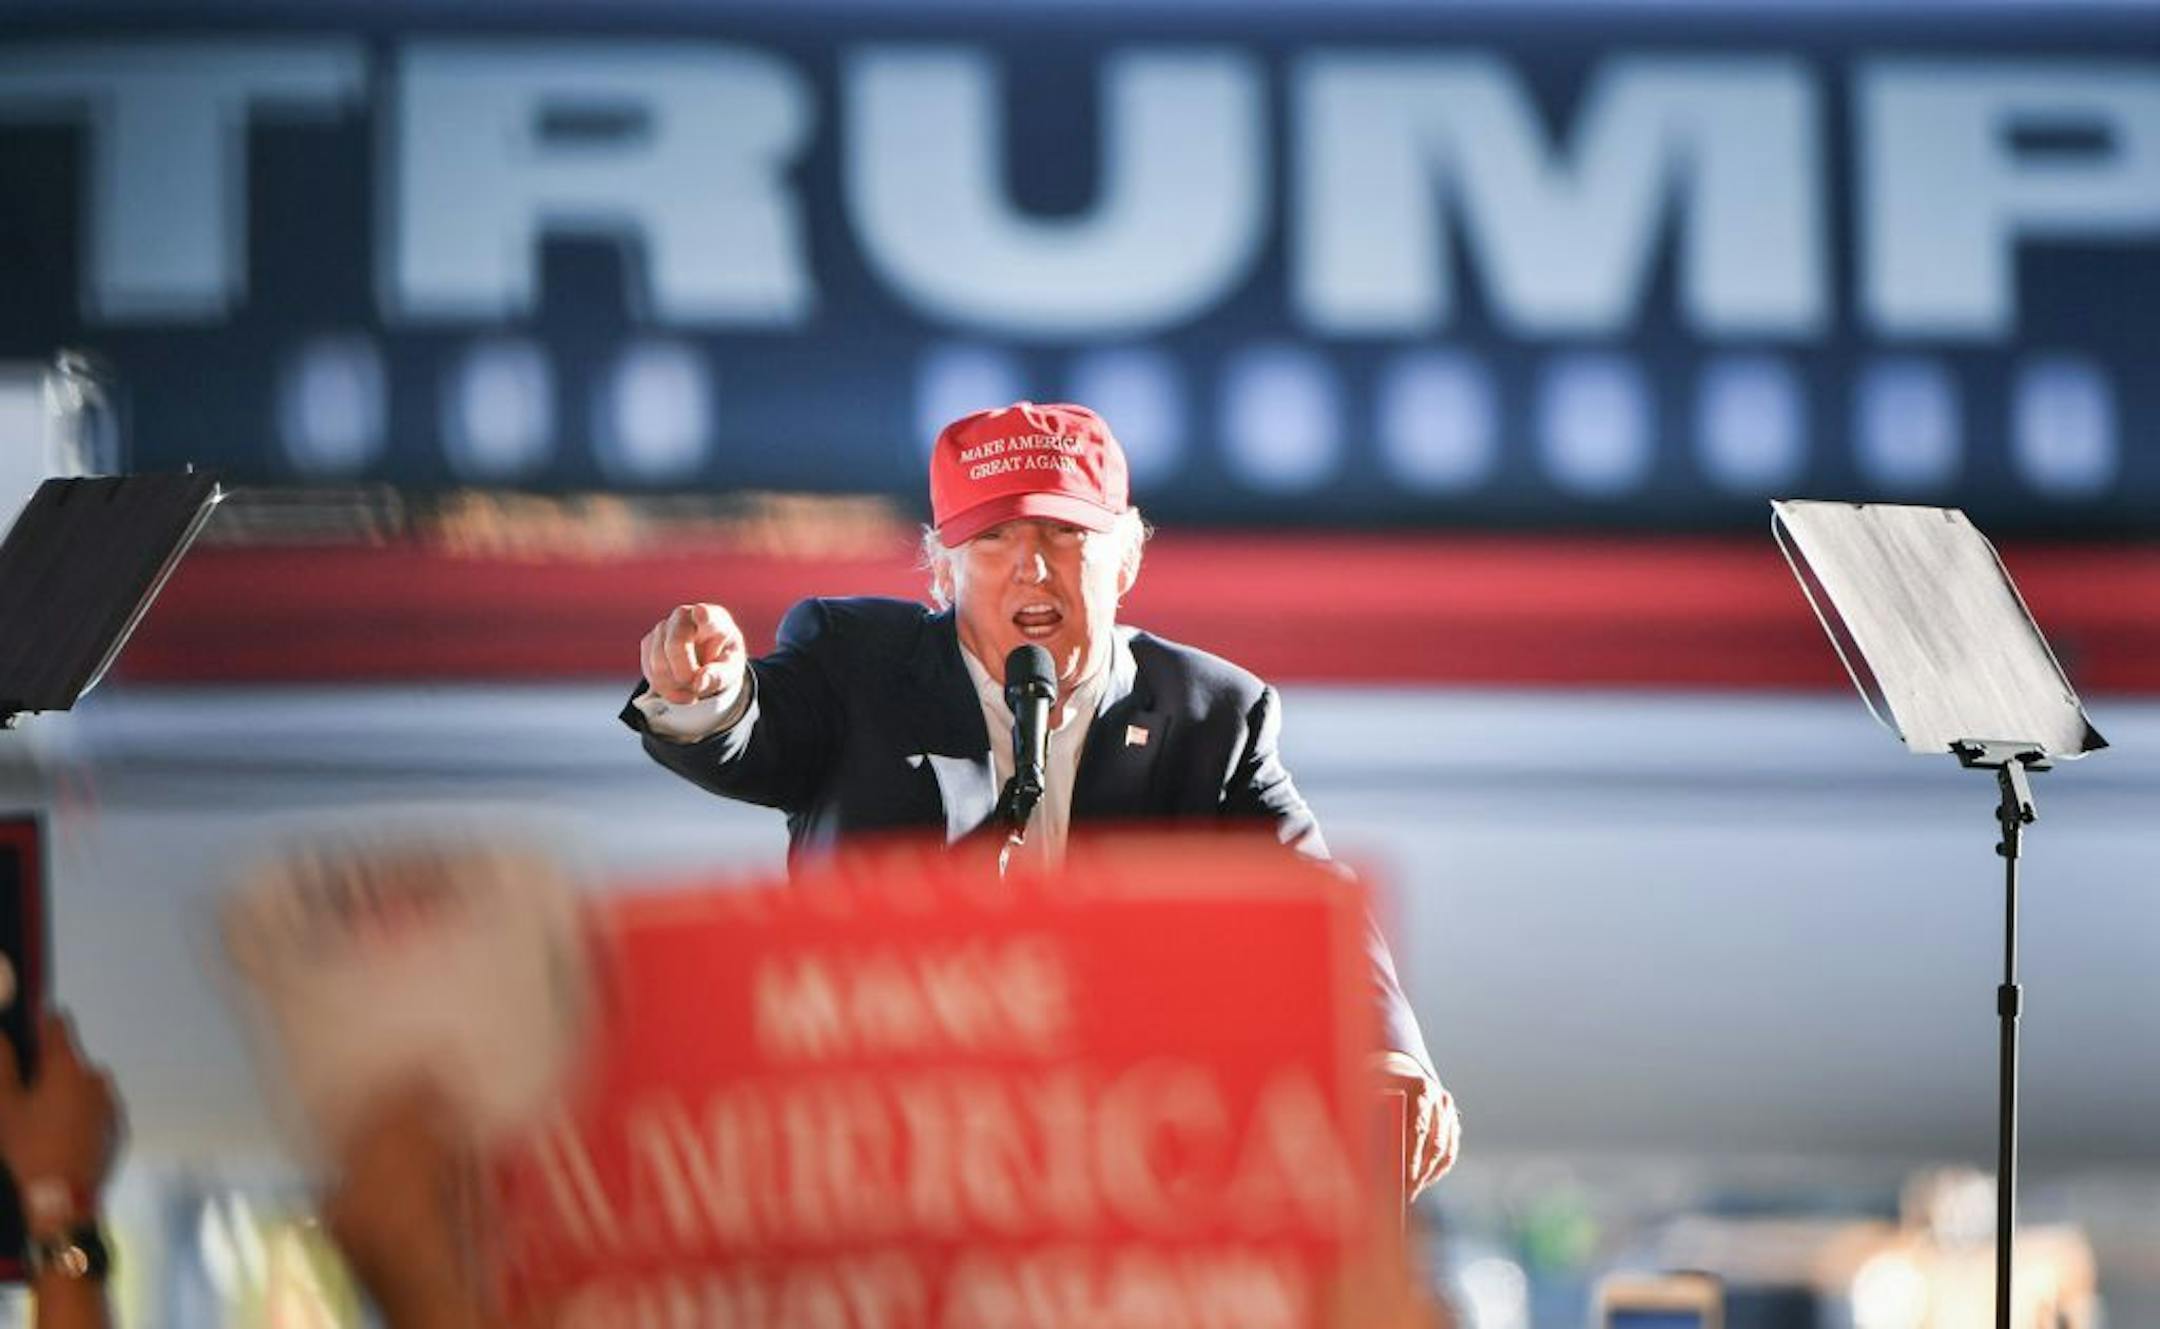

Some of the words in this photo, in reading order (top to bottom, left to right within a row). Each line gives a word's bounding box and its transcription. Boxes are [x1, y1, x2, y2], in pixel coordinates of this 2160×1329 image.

[0, 38, 2160, 342] TRUMP
[960, 438, 1006, 462] MAKE
[1007, 434, 1084, 453] AMERICA
[969, 456, 1022, 480] GREAT
[1024, 454, 1078, 473] AGAIN
